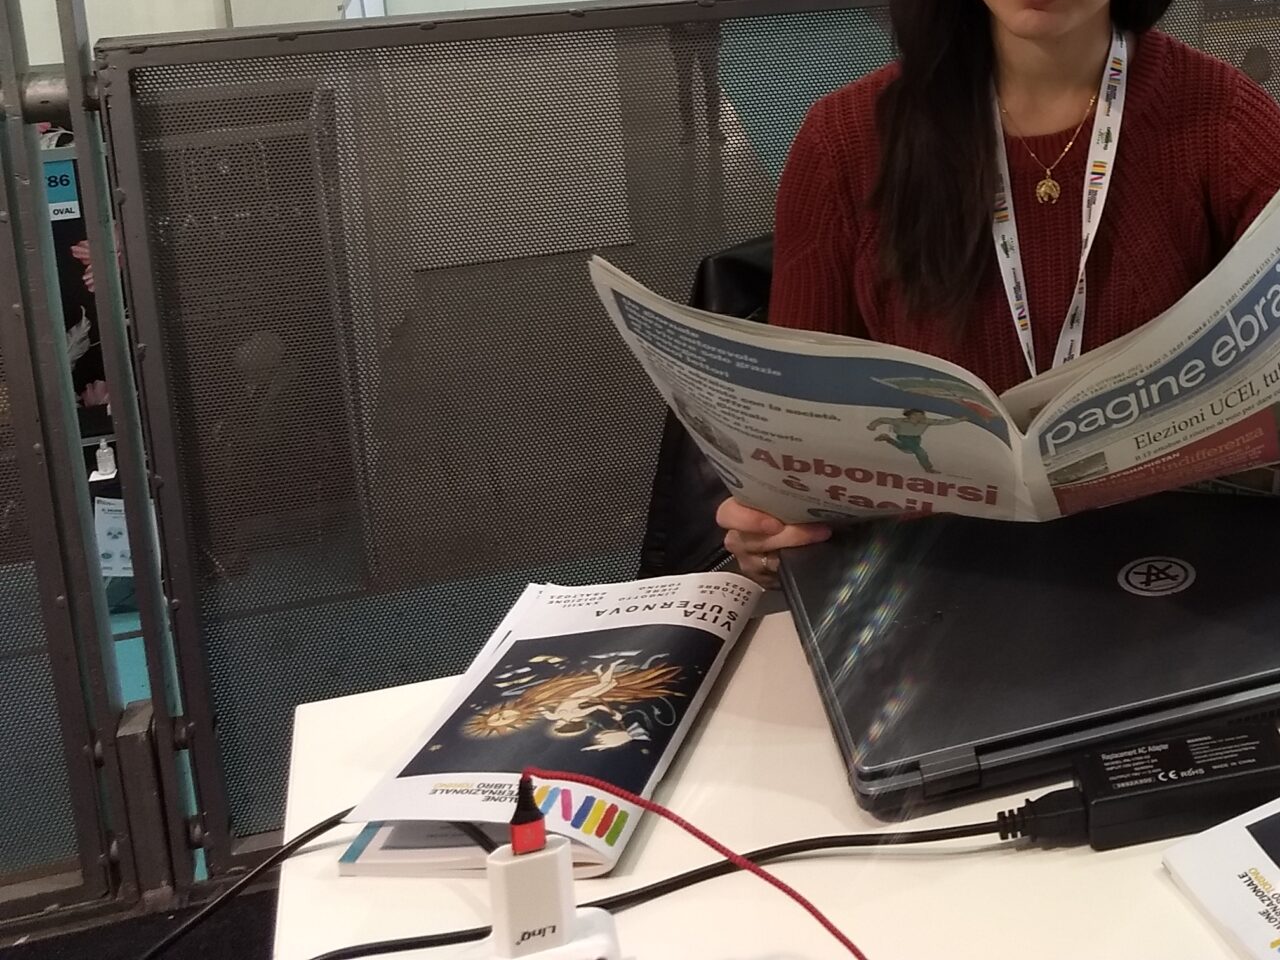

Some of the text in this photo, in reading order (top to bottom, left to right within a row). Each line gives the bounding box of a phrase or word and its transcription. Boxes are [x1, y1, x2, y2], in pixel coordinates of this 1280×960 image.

[46, 174, 70, 188] 86
[52, 207, 76, 216] OVAL
[736, 361, 782, 377] grazie
[1044, 357, 1207, 456] pagine
[1133, 408, 1207, 450] Elezioni
[751, 448, 998, 505] Abbonarsi
[782, 475, 810, 492] è
[617, 592, 677, 602] LINGOTTO
[697, 584, 750, 602] OTTOBRE
[724, 581, 753, 597] 2021
[547, 596, 604, 605] EDIZIONE
[594, 600, 739, 622] SUPERNOVA
[683, 610, 733, 632] VITA
[429, 789, 519, 798] TERNAZIONALE
[482, 795, 519, 804] ALONE
